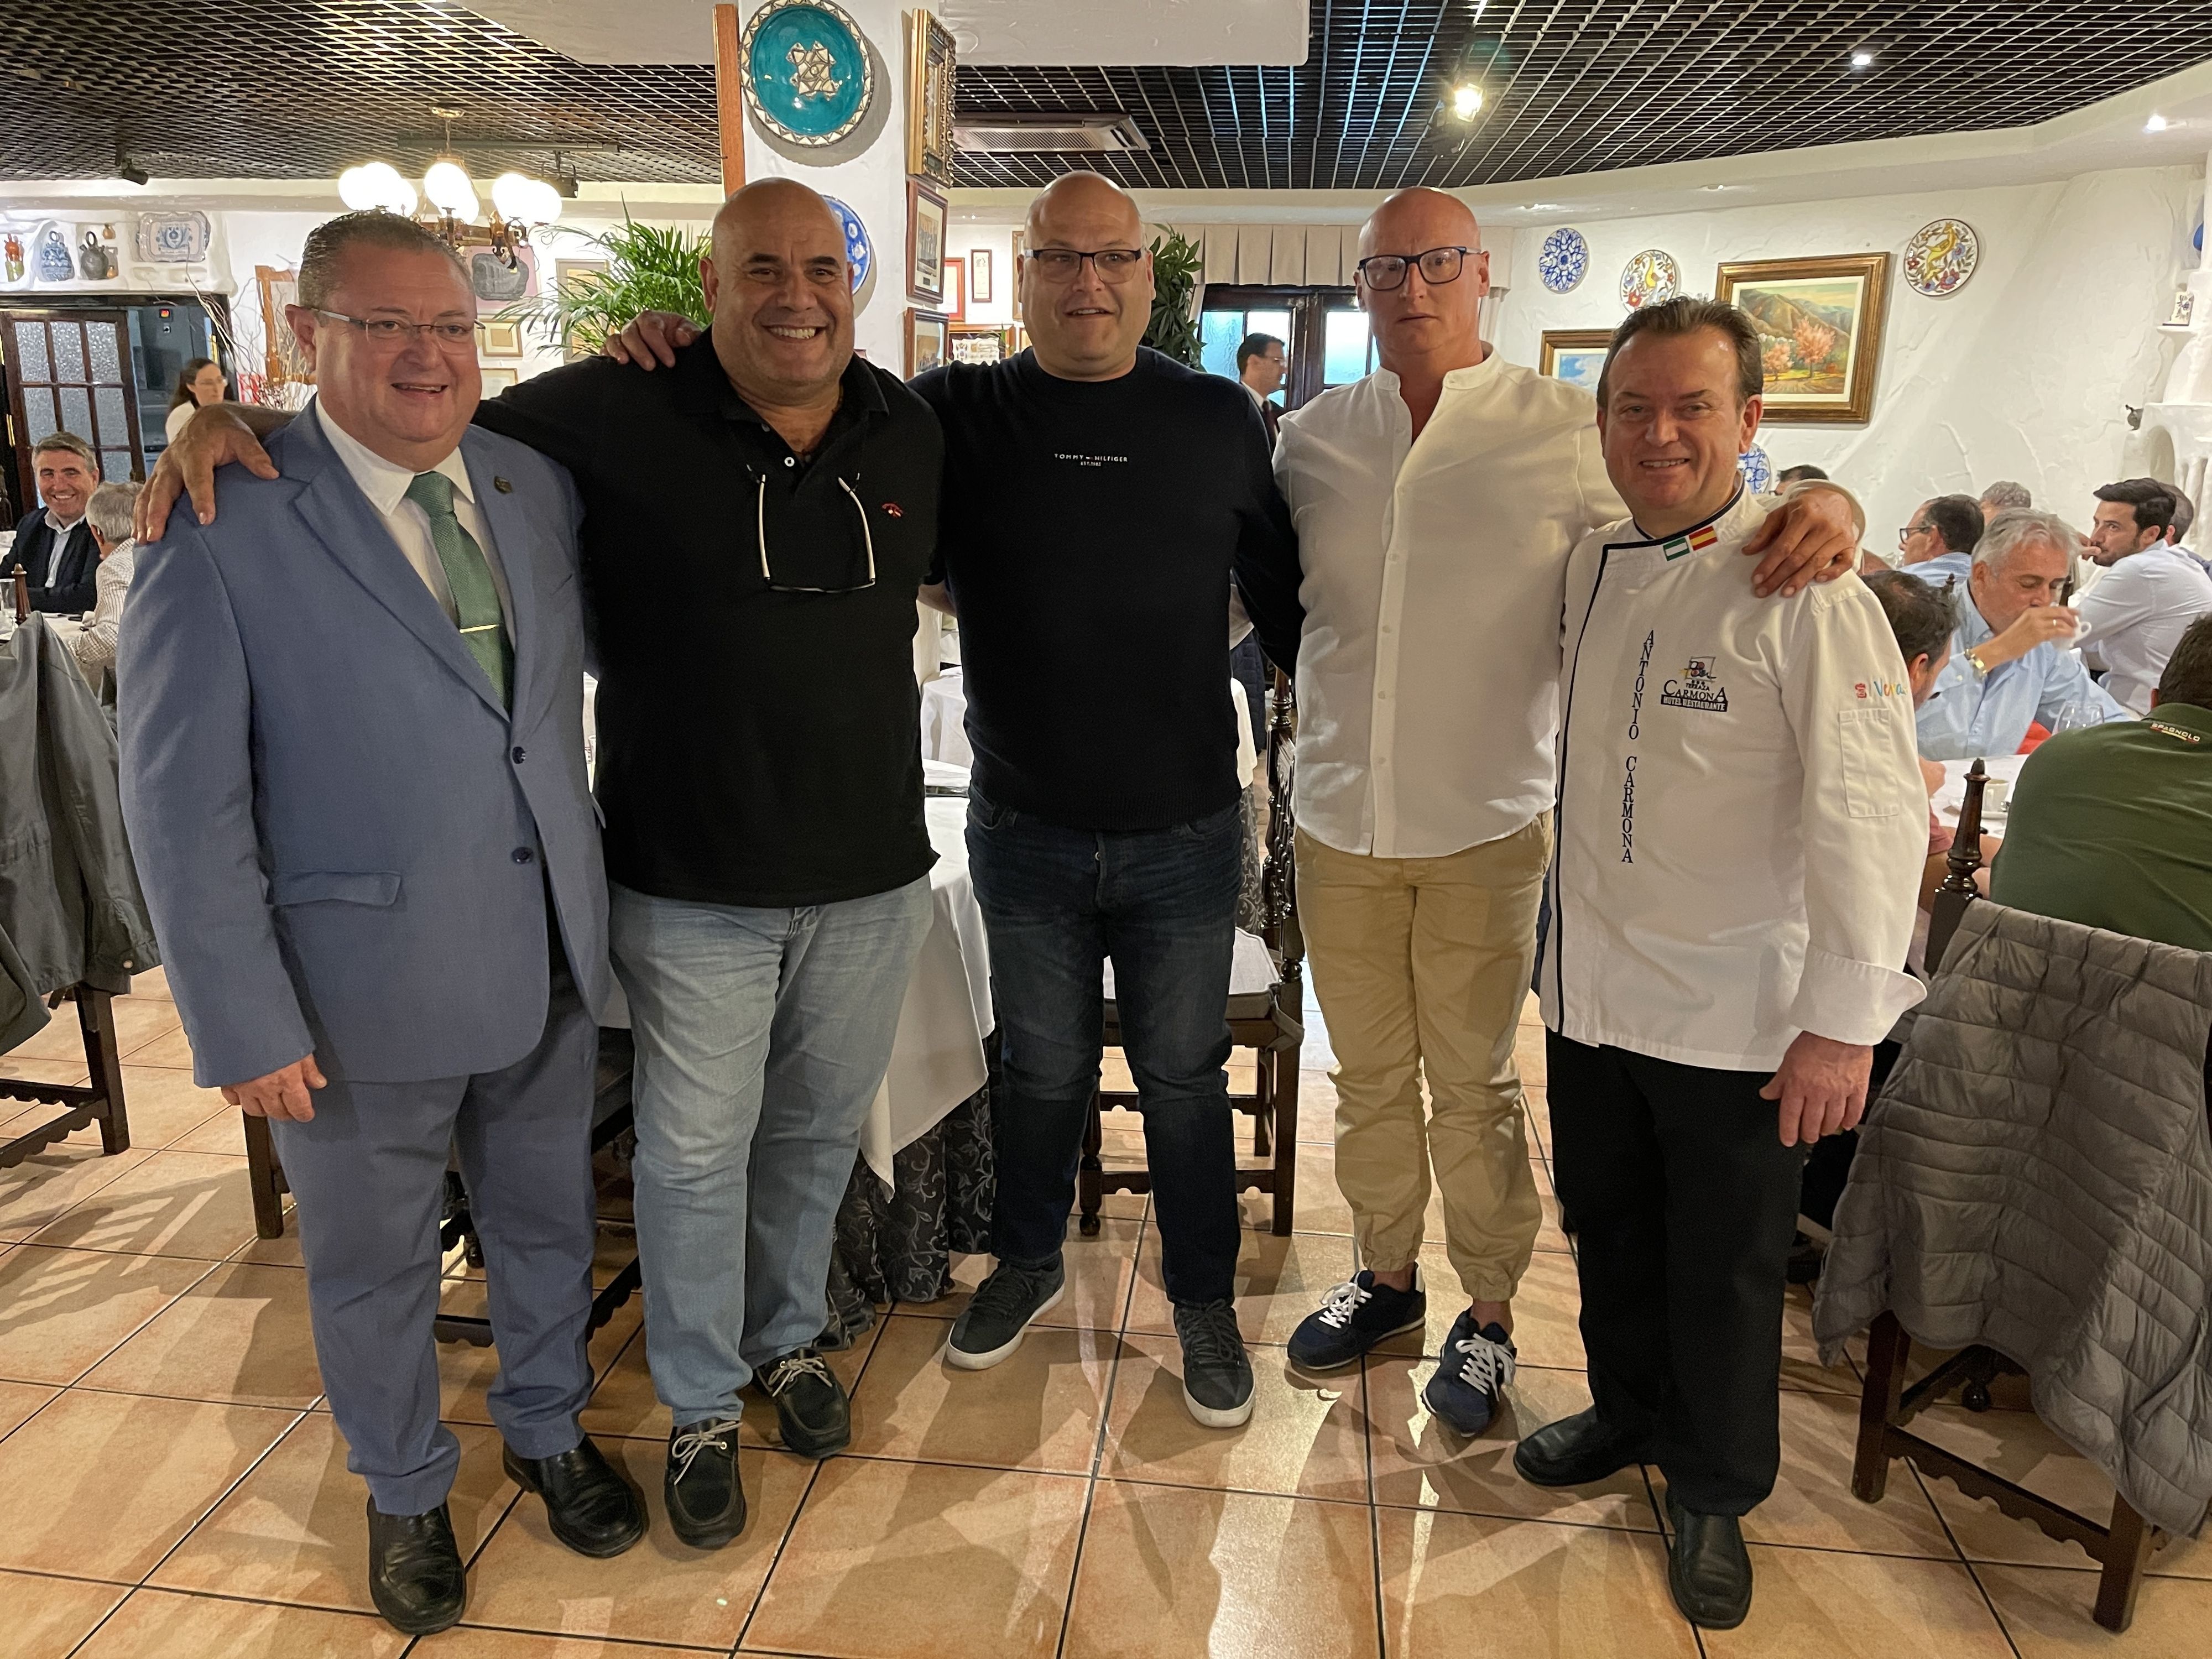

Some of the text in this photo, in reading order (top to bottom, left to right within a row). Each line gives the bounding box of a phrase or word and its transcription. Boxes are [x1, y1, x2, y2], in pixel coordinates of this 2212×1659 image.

[1686, 682, 1710, 691] TERRAZA
[1663, 696, 1725, 711] HOTEL RESTAURANTE
[2151, 723, 2200, 742] SPAGNOLO
[1621, 629, 1655, 864] ANTONIO CARMONA
